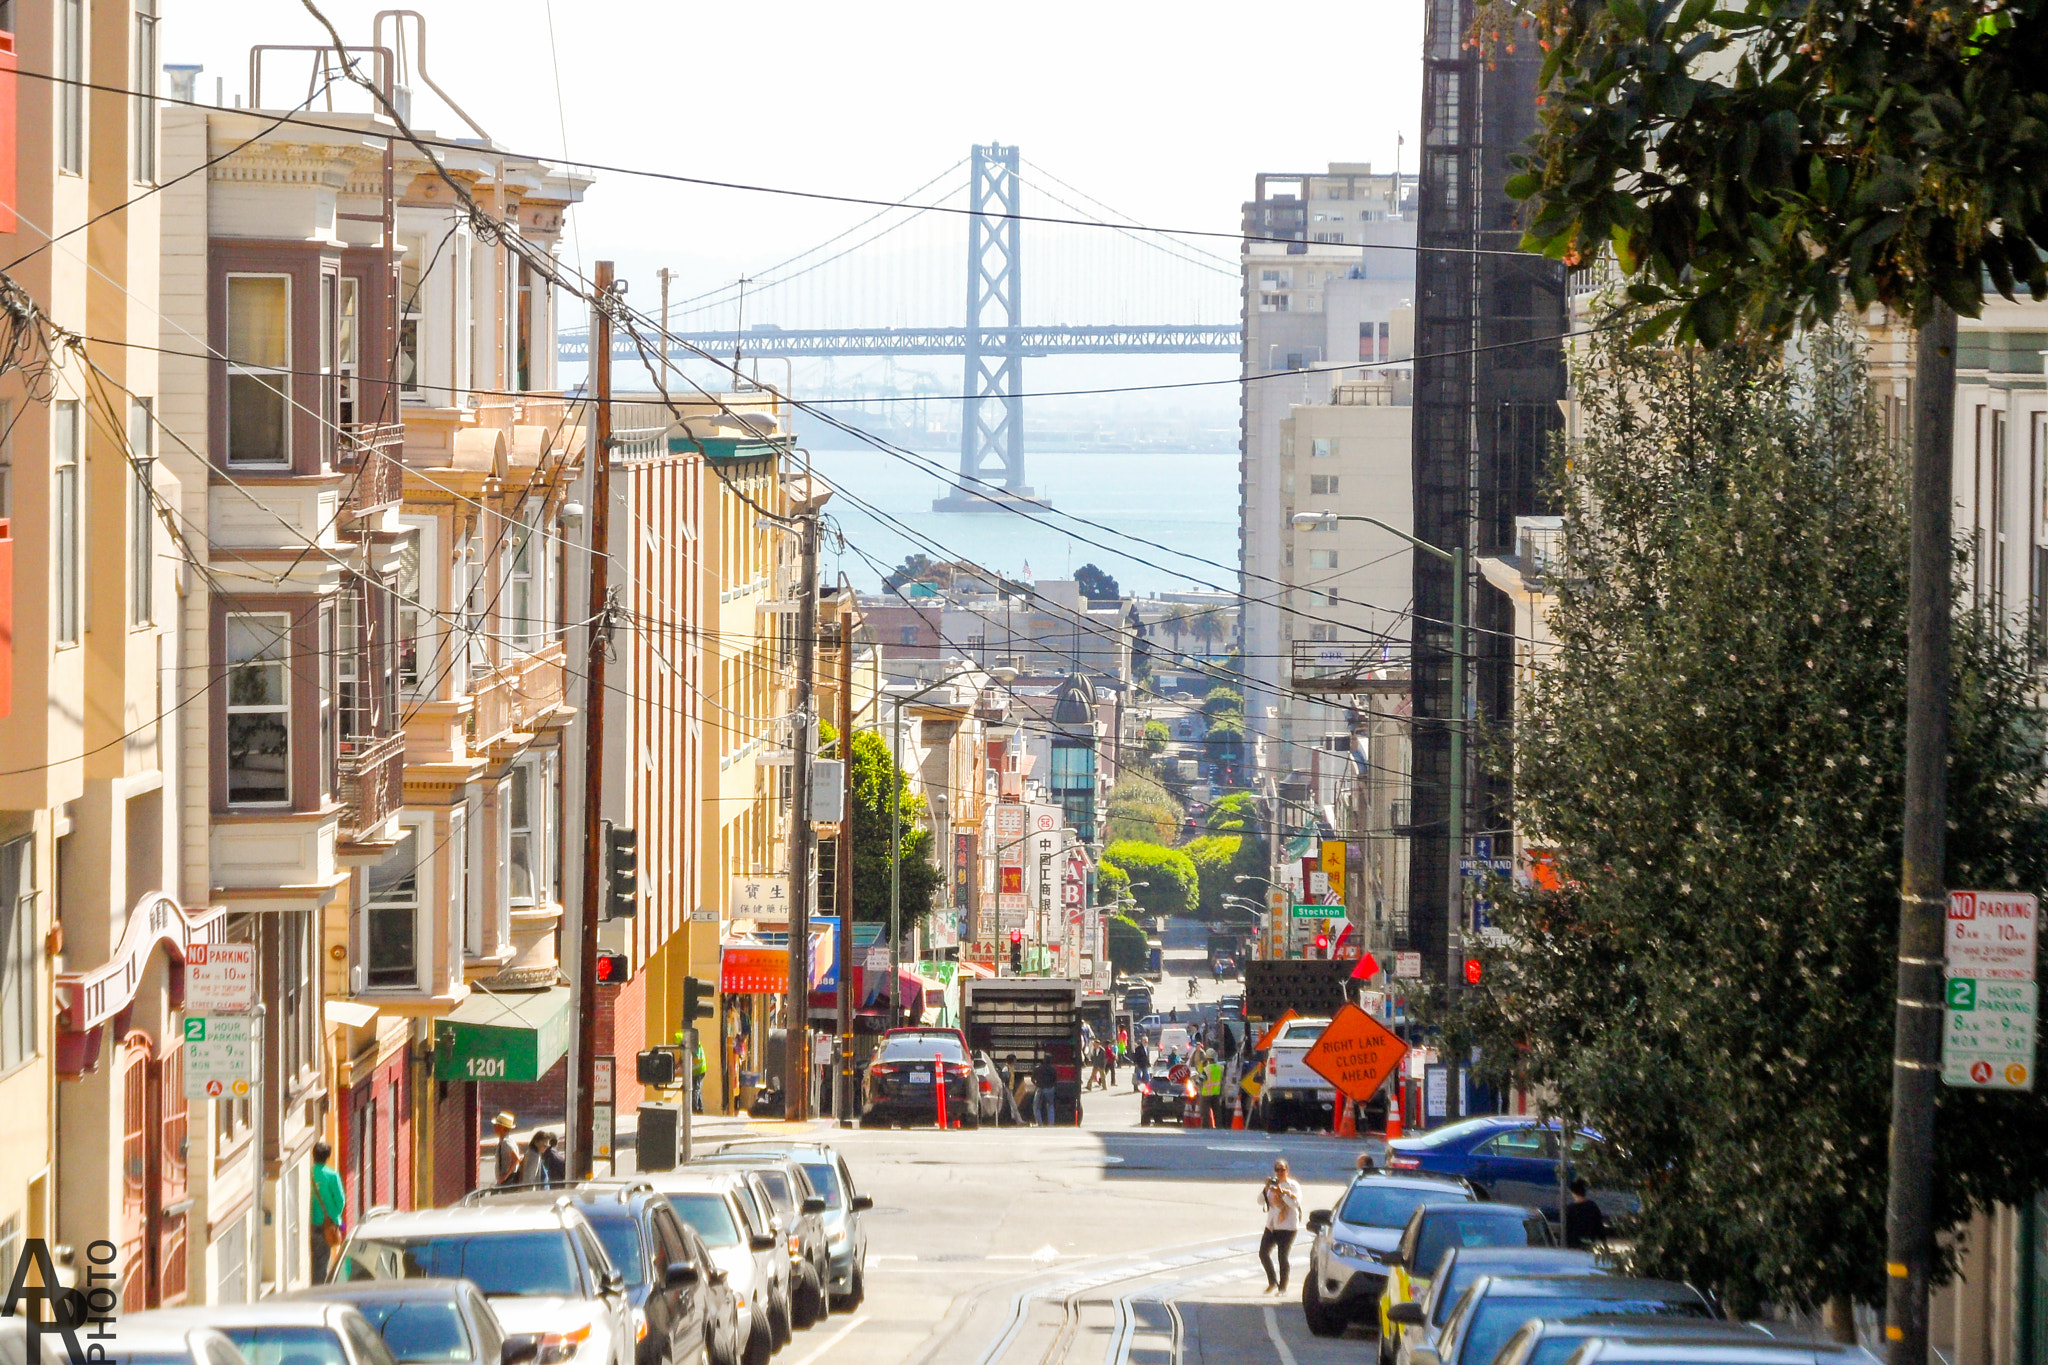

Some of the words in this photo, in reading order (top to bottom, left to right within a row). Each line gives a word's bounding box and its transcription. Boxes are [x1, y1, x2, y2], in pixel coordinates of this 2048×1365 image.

[1298, 908, 1340, 916] Stockton
[1950, 895, 1972, 917] NO
[1979, 901, 2031, 919] PARKING
[188, 946, 205, 963] NO
[209, 950, 249, 964] PARKING
[1953, 982, 1971, 1005] 2
[1987, 986, 2022, 999] HOUR
[1978, 999, 2032, 1014] PARKING
[187, 1020, 202, 1039] 2
[214, 1022, 240, 1031] HOUR
[207, 1033, 247, 1041] PARKING
[1322, 1039, 1354, 1054] RIGHT
[1359, 1035, 1387, 1049] LANE
[466, 1058, 505, 1077] 1201
[1336, 1052, 1378, 1068] CLOSED
[1170, 1066, 1188, 1082] STOP
[1341, 1068, 1377, 1082] AHEAD
